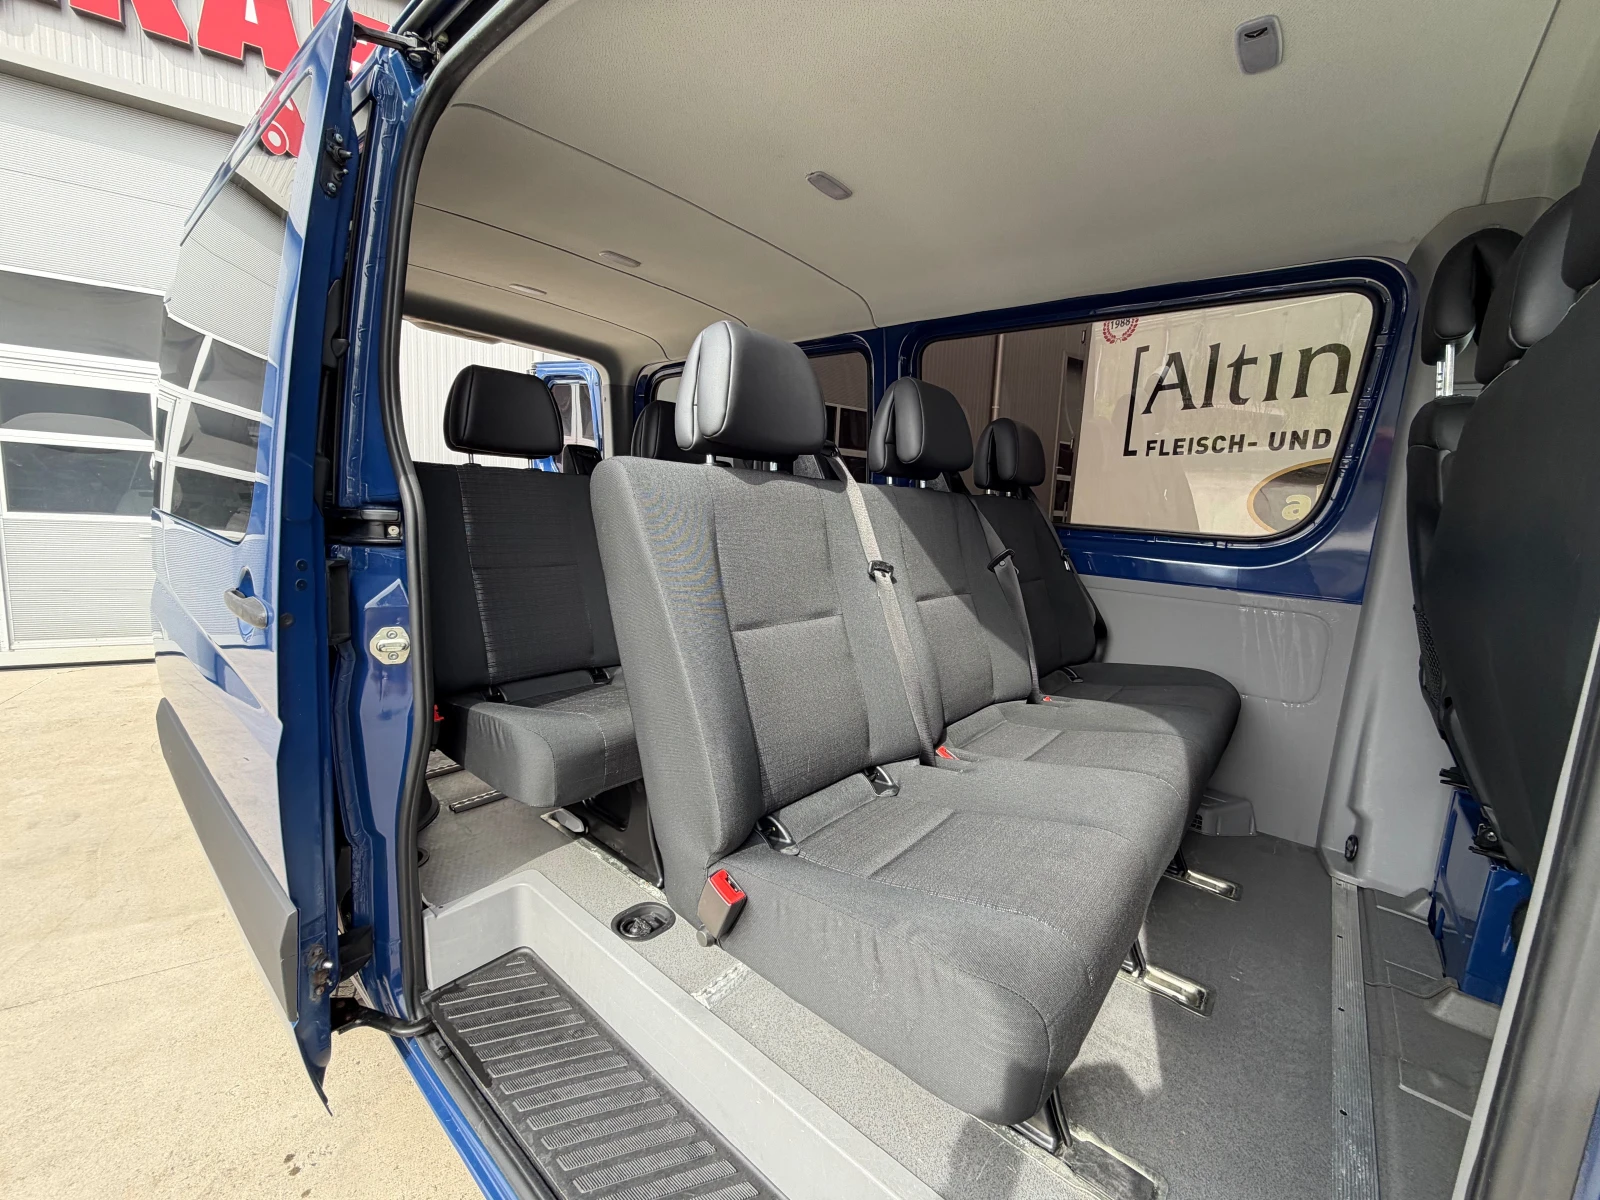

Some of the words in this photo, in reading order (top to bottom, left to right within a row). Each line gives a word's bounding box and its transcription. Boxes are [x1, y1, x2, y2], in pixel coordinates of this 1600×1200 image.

[1110, 318, 1131, 330] 1988
[1145, 434, 1258, 457] FLEISCH-
[1268, 428, 1332, 451] UND
